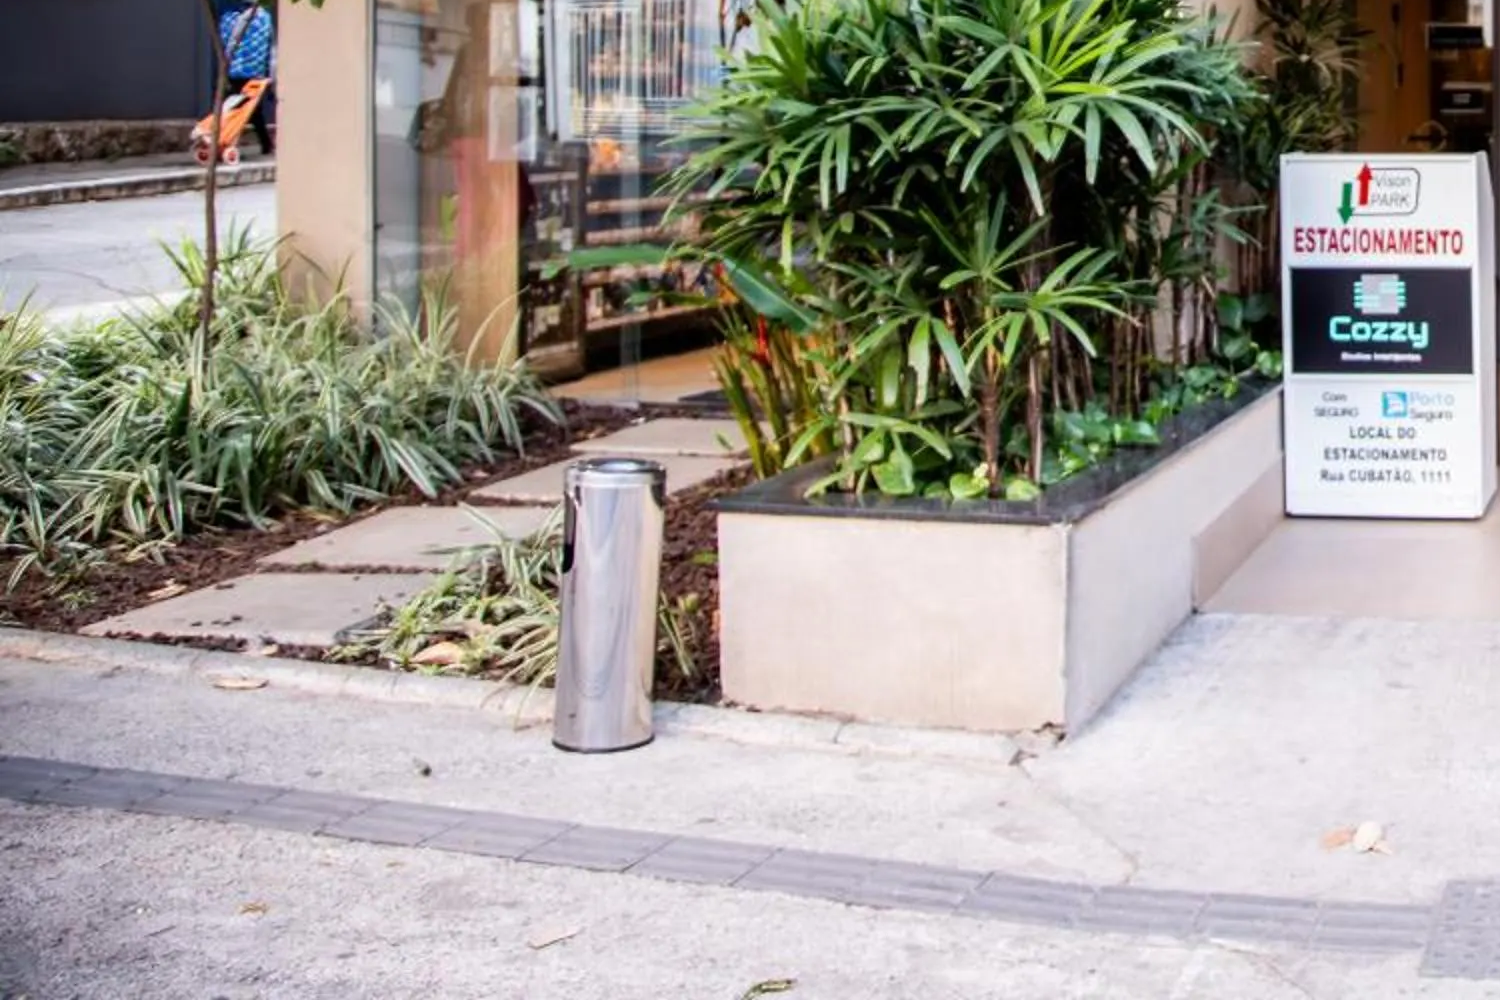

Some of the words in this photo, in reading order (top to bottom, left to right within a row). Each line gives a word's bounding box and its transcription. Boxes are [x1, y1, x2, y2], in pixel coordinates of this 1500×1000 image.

[1371, 193, 1411, 208] PARK
[1293, 226, 1464, 255] ESTACIONAMENTO
[1329, 315, 1429, 349] Cozzy
[1321, 391, 1348, 402] Com
[1410, 391, 1456, 406] Porto
[1409, 408, 1453, 423] Seguro
[1348, 426, 1393, 440] LOCAL
[1397, 426, 1417, 440] DO
[1323, 447, 1448, 462] ESTACIONAMENTO
[1320, 469, 1345, 482] Rua
[1420, 469, 1452, 483] 1111
